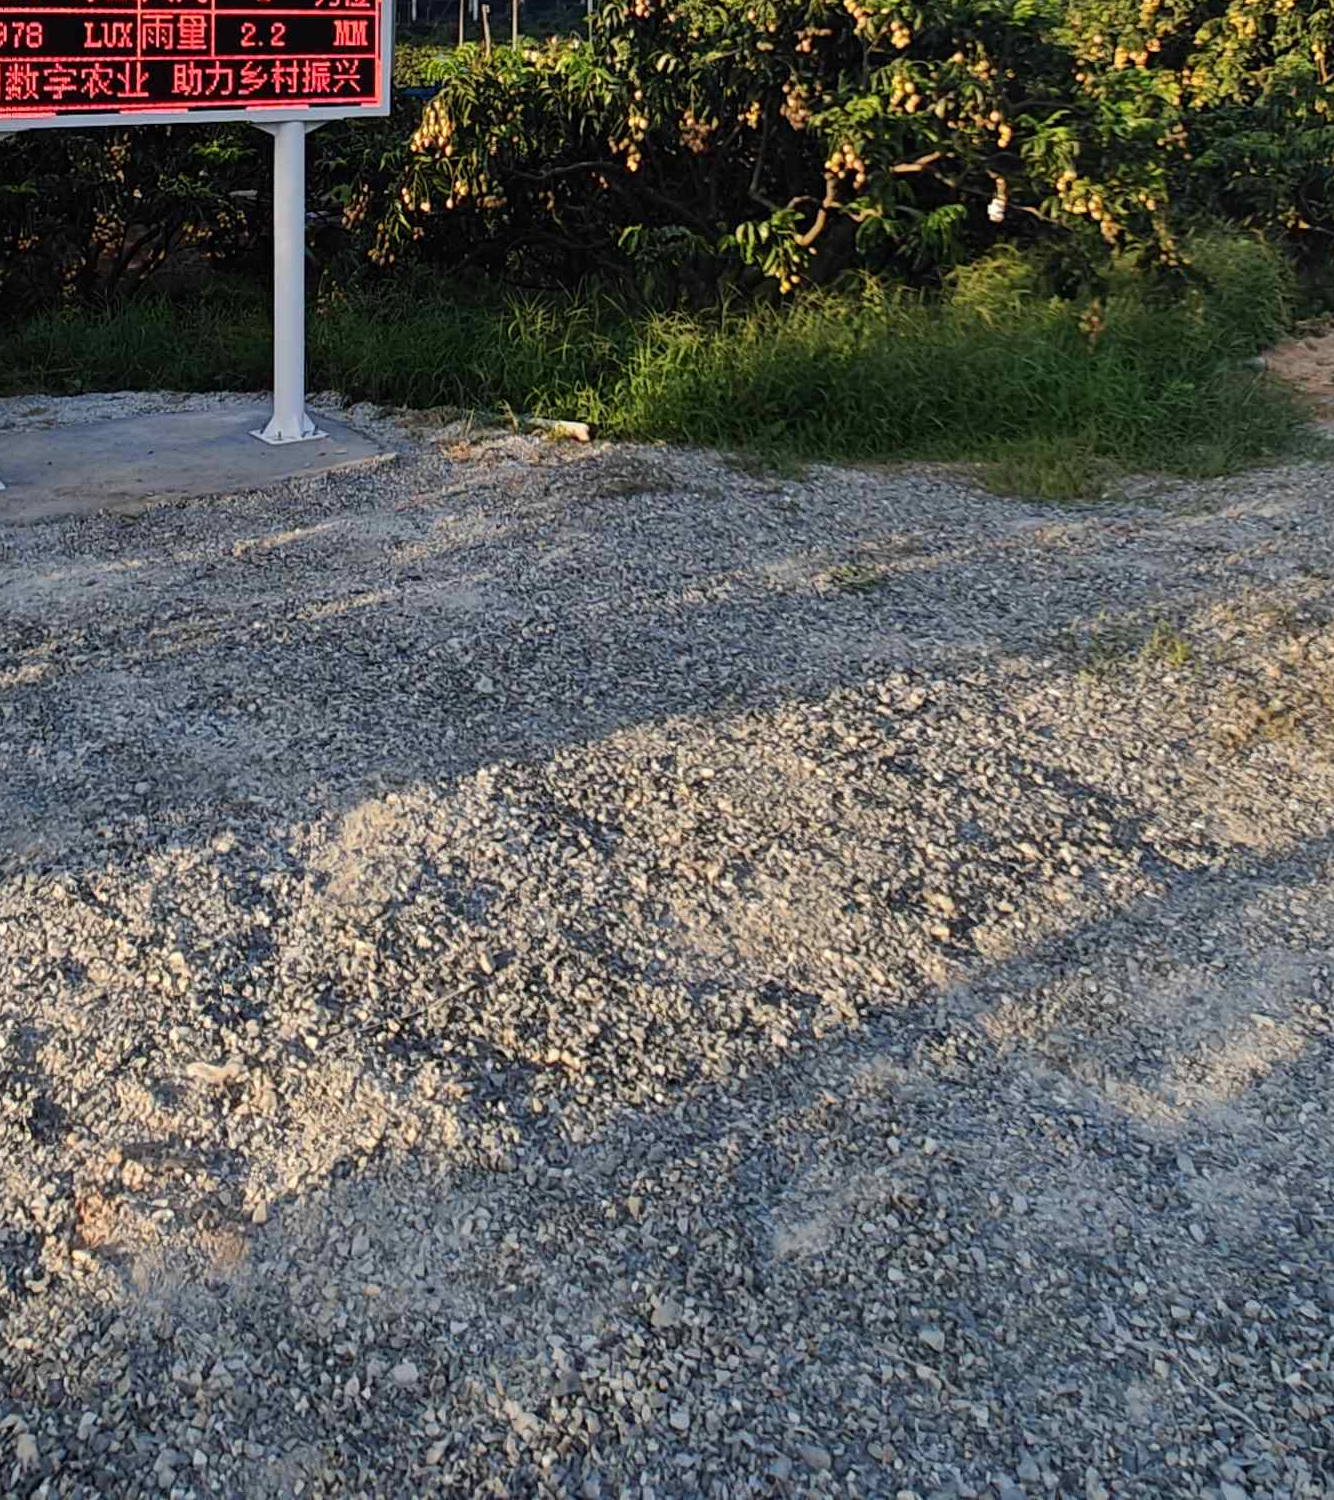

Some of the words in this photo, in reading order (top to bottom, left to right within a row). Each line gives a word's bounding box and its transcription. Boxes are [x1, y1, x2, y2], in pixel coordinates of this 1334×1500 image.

[83, 21, 134, 49] LUX
[142, 14, 207, 50] 雨量
[240, 22, 286, 47] 2.2
[172, 60, 362, 97] 助力乡村振兴
